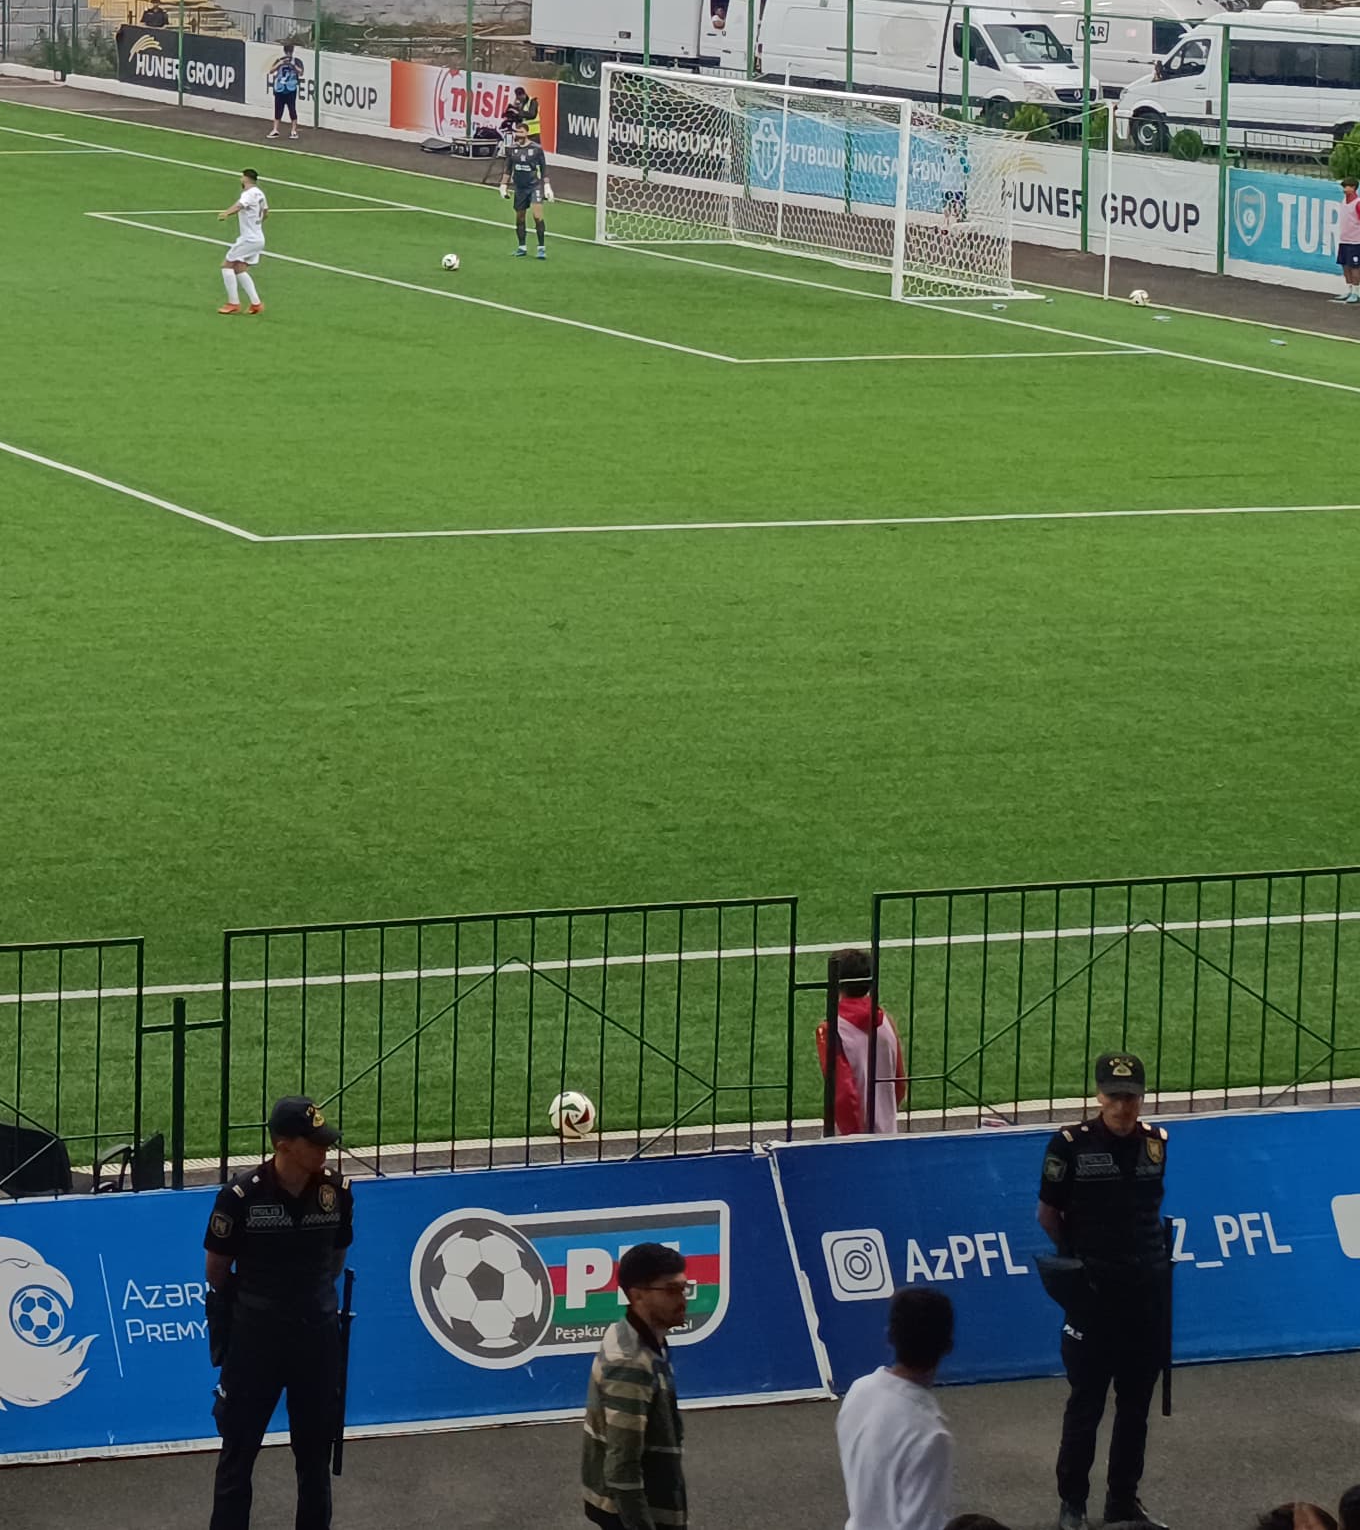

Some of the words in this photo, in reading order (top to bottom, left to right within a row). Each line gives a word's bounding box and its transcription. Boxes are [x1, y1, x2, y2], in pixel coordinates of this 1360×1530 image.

[136, 53, 180, 81] HUNER
[186, 60, 235, 90] GROUP
[267, 73, 316, 102] HER
[323, 81, 378, 110] GROUP
[1101, 192, 1200, 234] GROUP
[906, 1231, 1029, 1283] AzPFL
